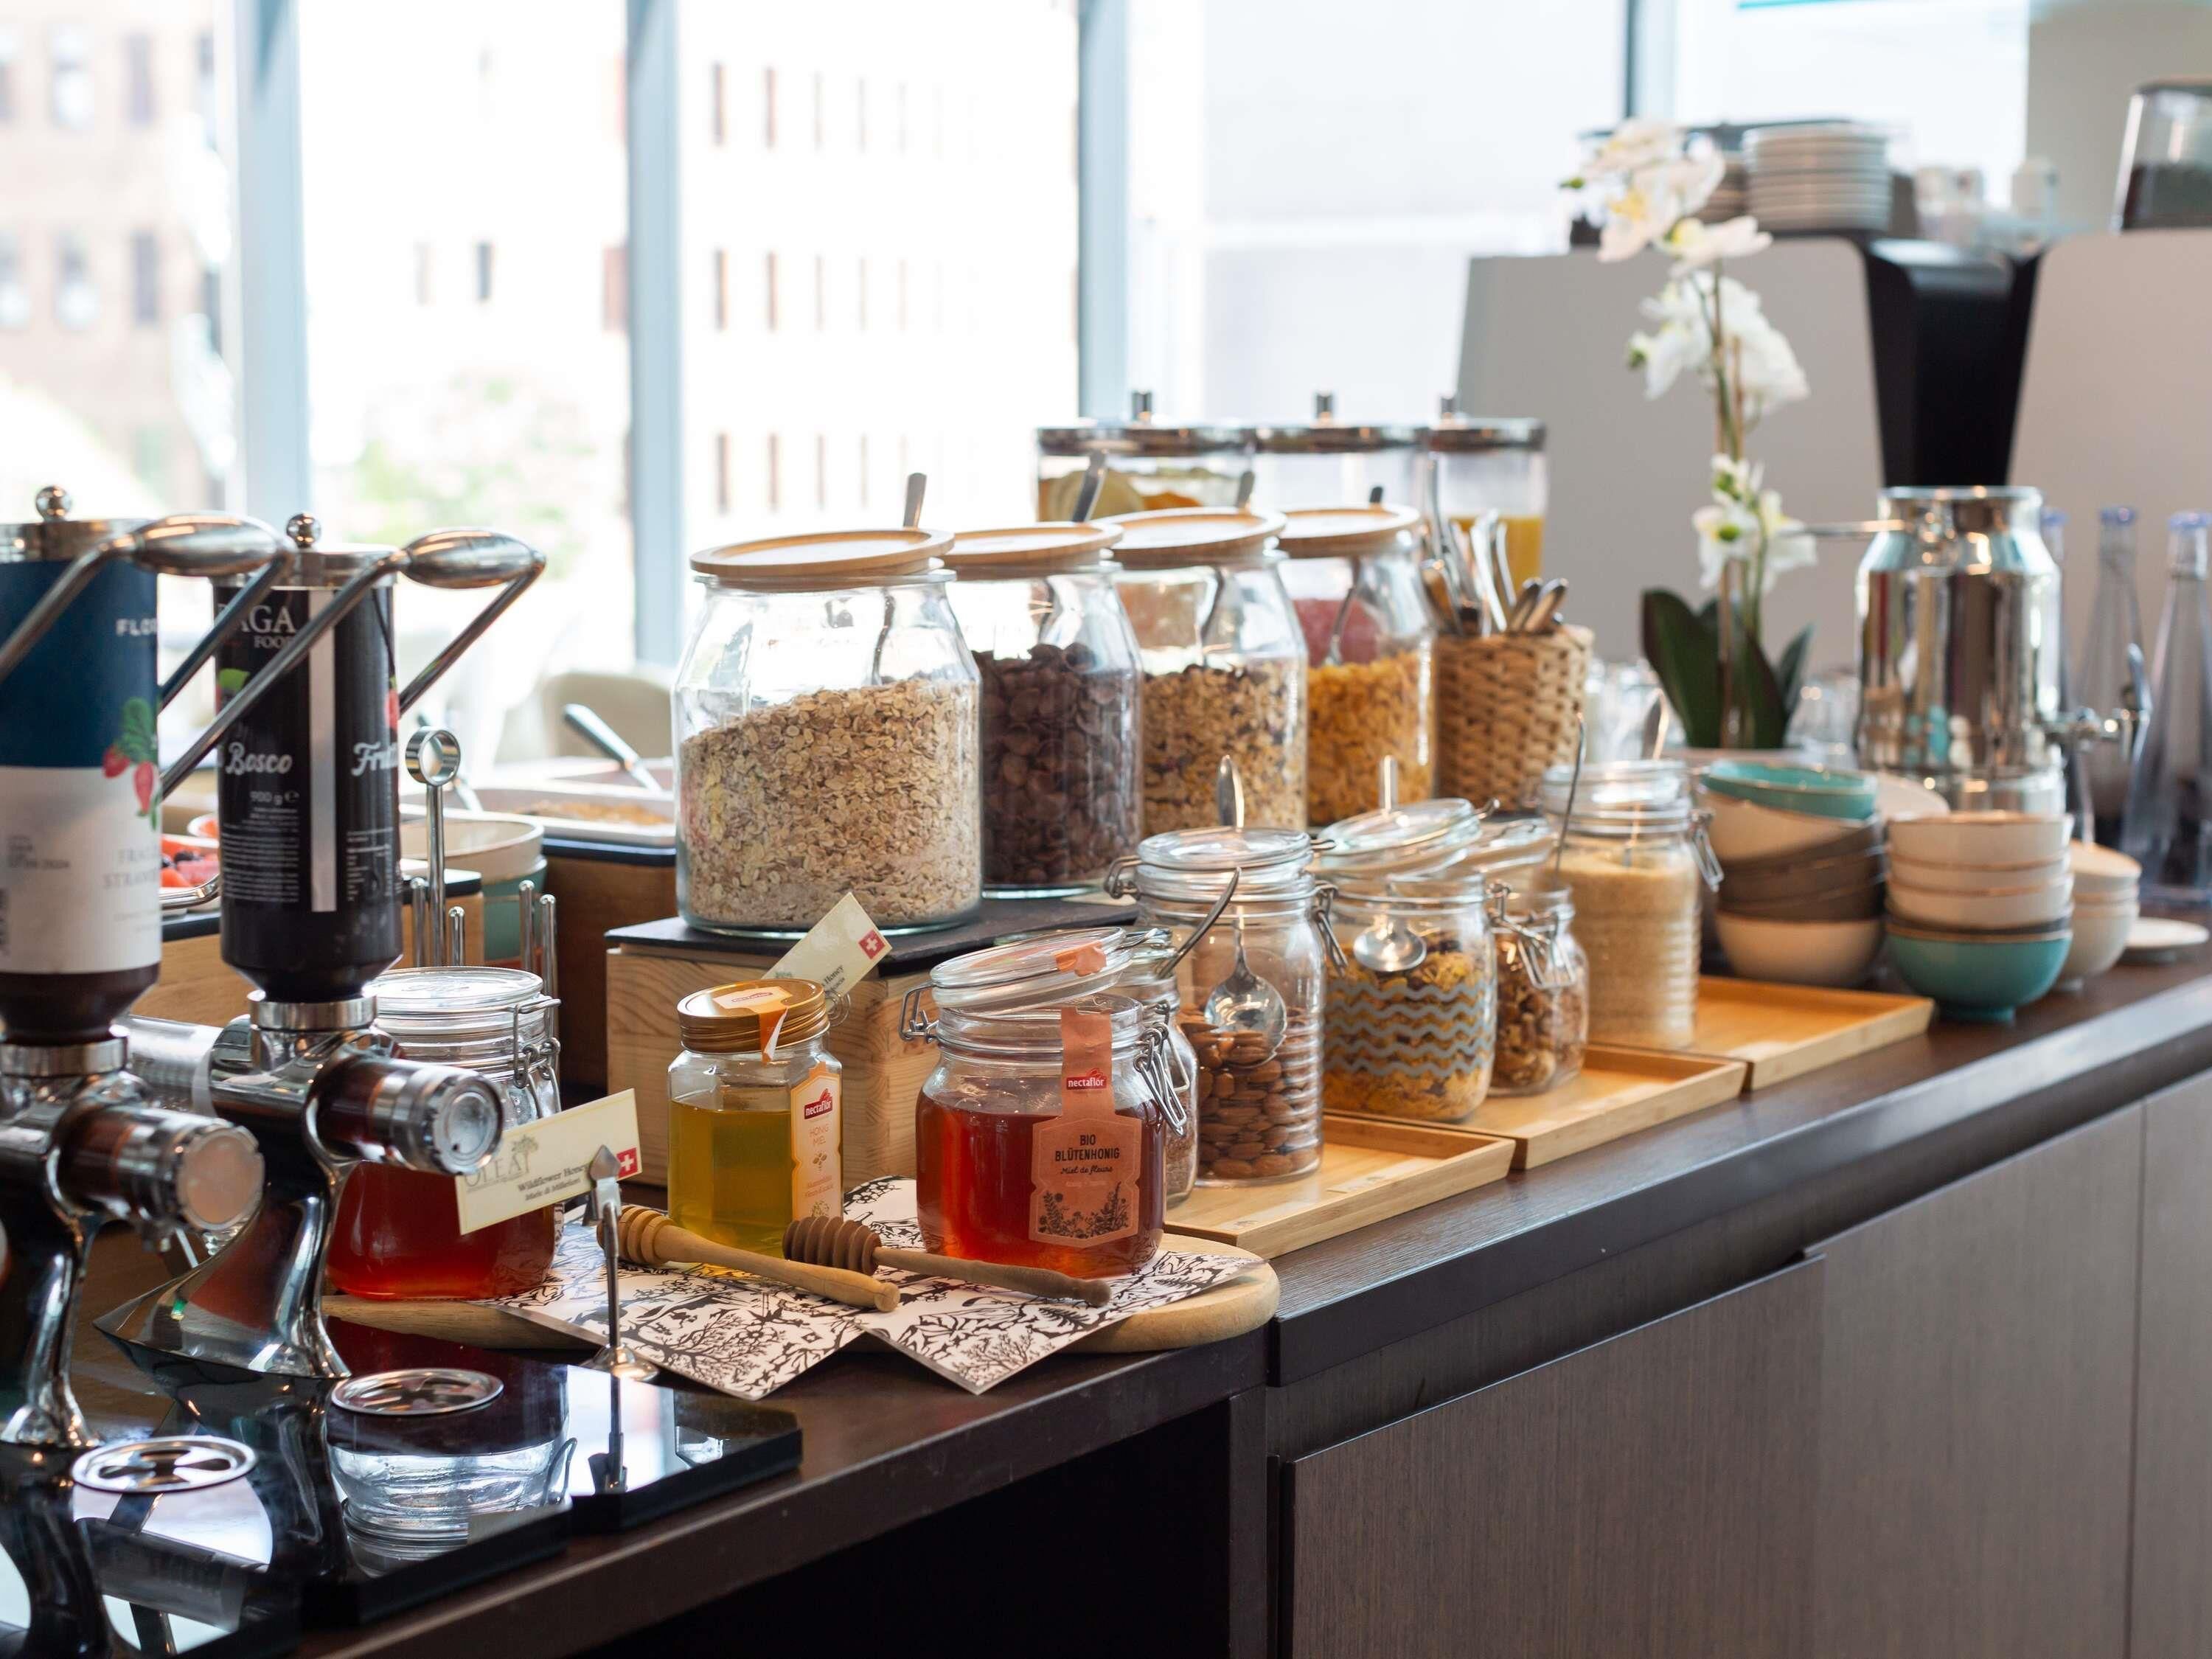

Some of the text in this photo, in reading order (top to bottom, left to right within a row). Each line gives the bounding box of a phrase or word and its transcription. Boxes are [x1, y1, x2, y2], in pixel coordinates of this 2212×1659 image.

[226, 741, 293, 775] Bosco
[824, 964, 845, 986] Honey
[1079, 1135, 1096, 1146] BIO
[1055, 1147, 1120, 1162] BLÜTENHONIG
[1060, 1166, 1079, 1175] Miel
[518, 1172, 563, 1192] Wildflower
